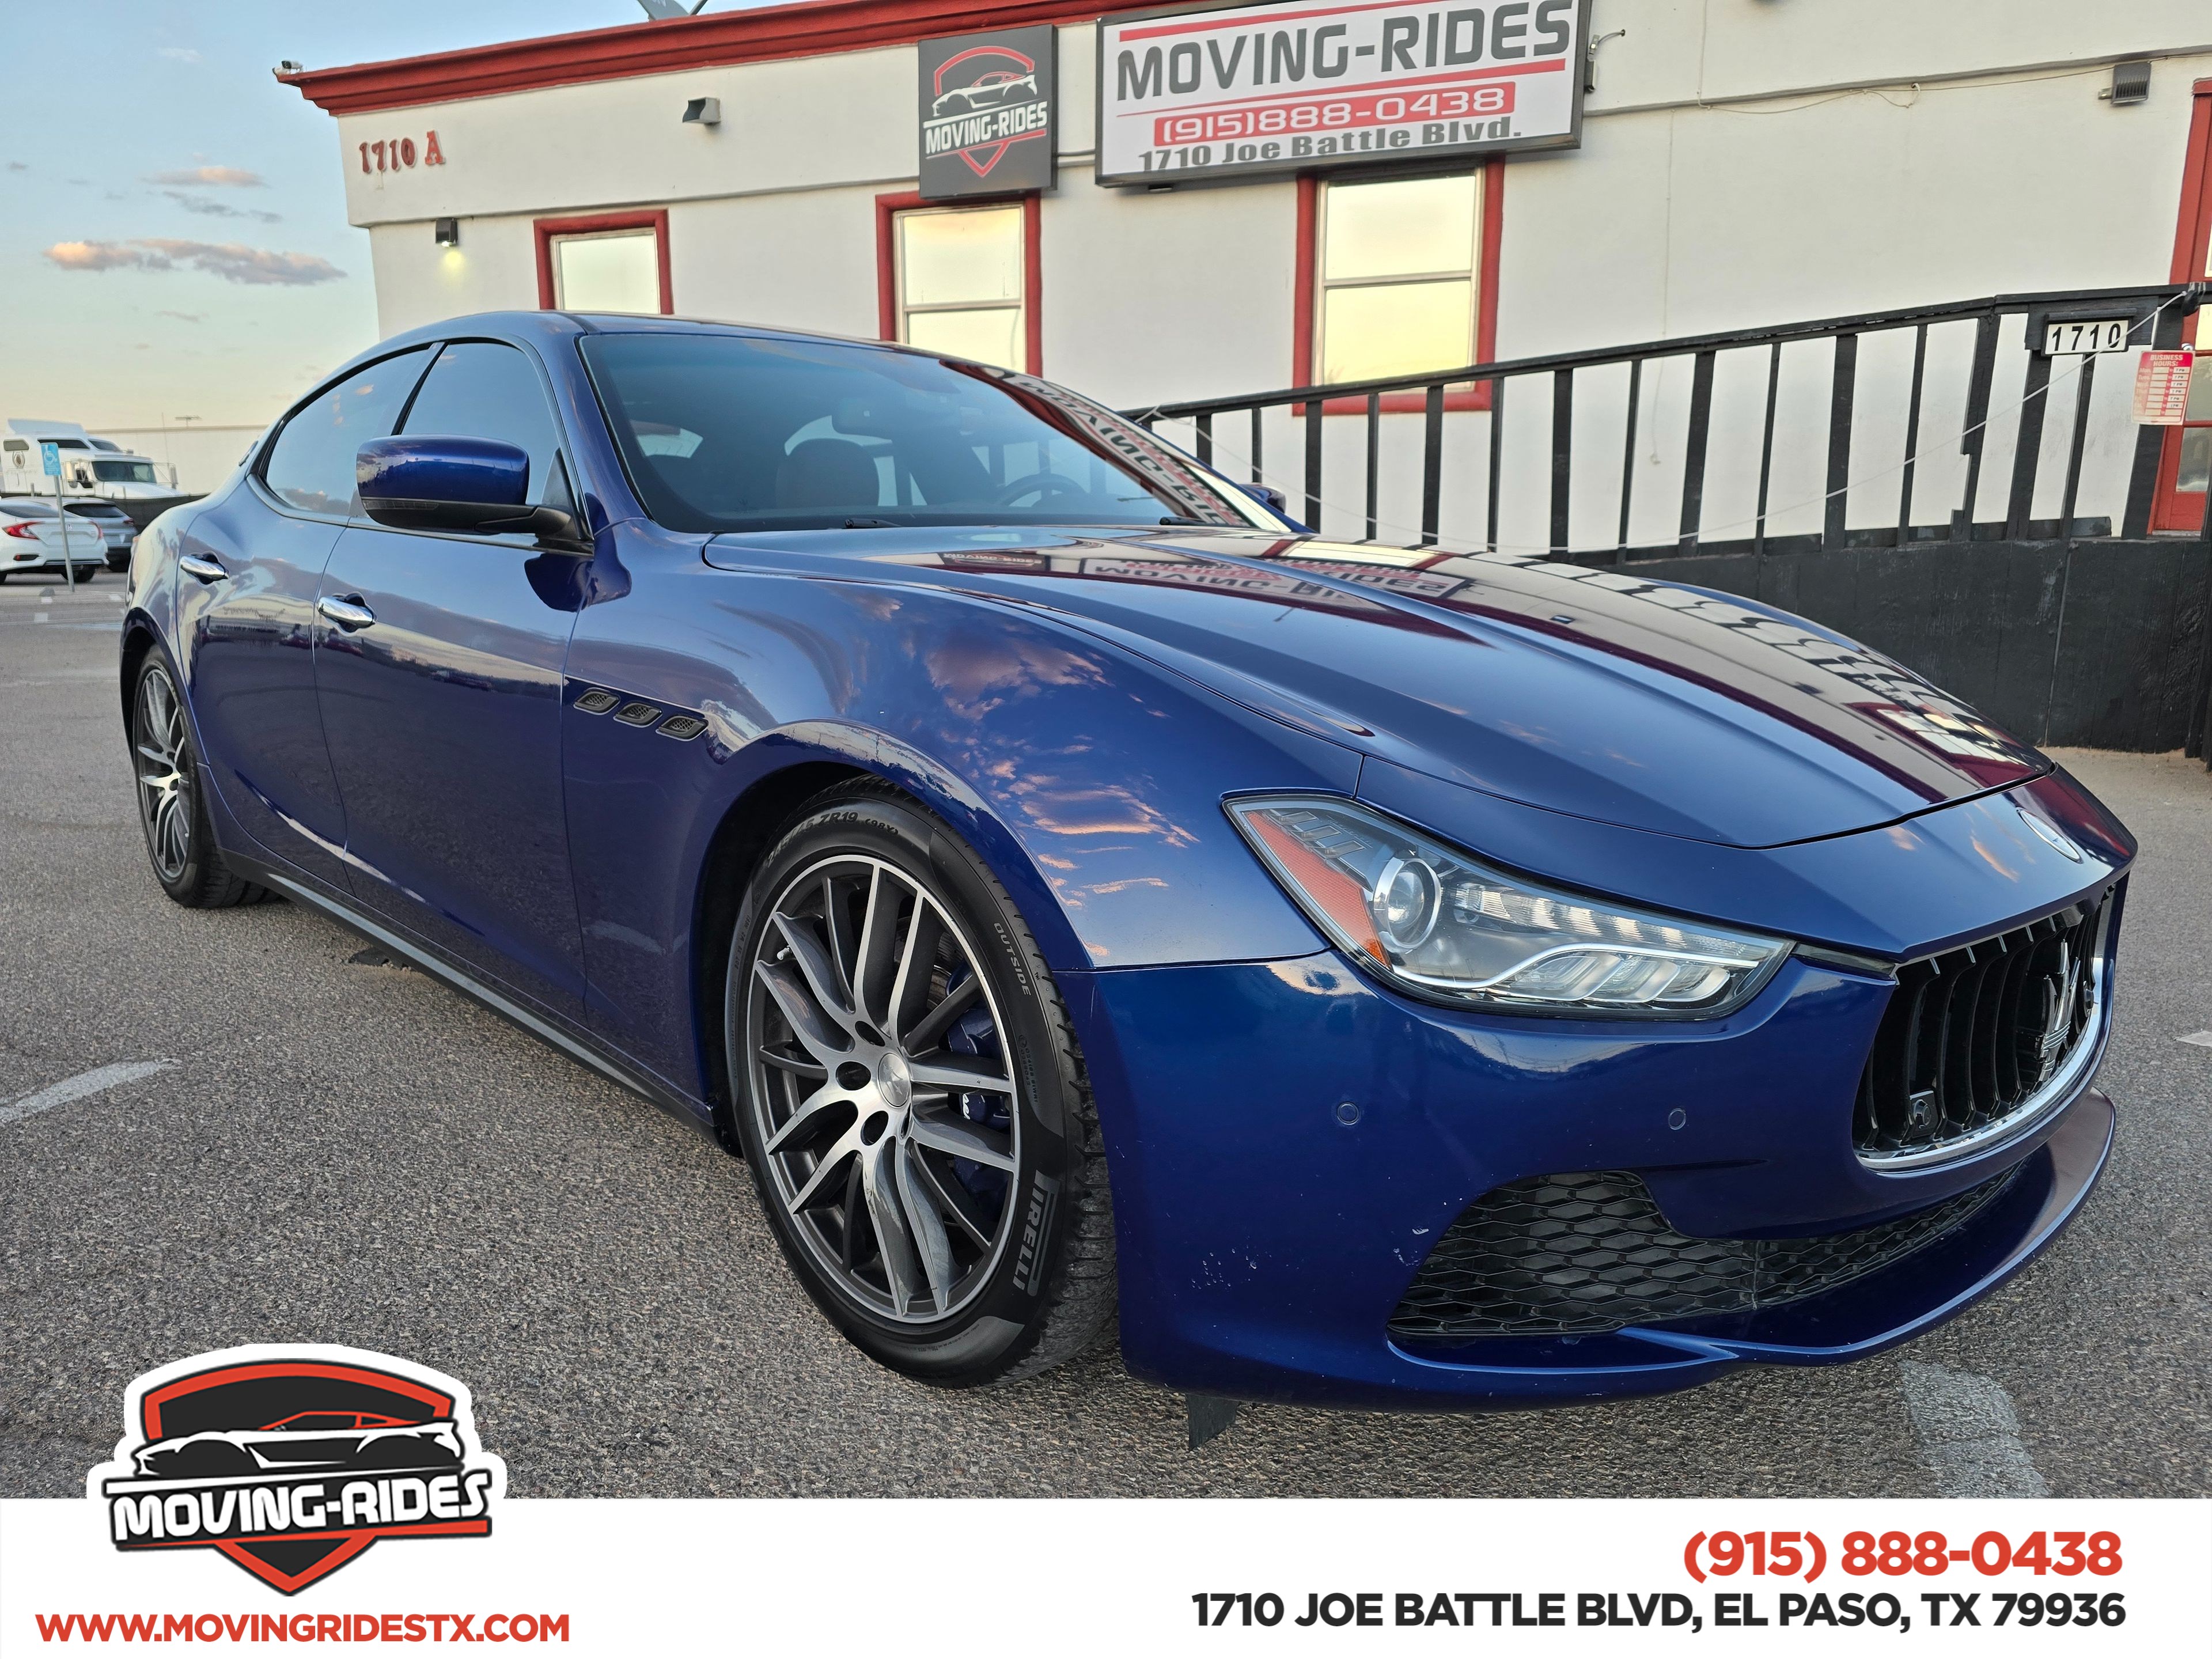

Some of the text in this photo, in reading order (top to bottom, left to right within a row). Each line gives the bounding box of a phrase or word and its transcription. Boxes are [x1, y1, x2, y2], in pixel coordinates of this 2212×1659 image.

[1118, 0, 1573, 101] MOVING-RIDES
[925, 101, 1047, 154] MOVING-RIDES
[1163, 87, 1505, 143] (915)888-0438
[359, 130, 444, 173] 1710 A
[1138, 116, 1521, 172] 1710 Joe Battle Blvd.
[2052, 323, 2122, 351] 1710
[818, 811, 858, 825] ZR19
[865, 818, 899, 835] (98Y)
[994, 922, 1031, 996] OUTSIDE
